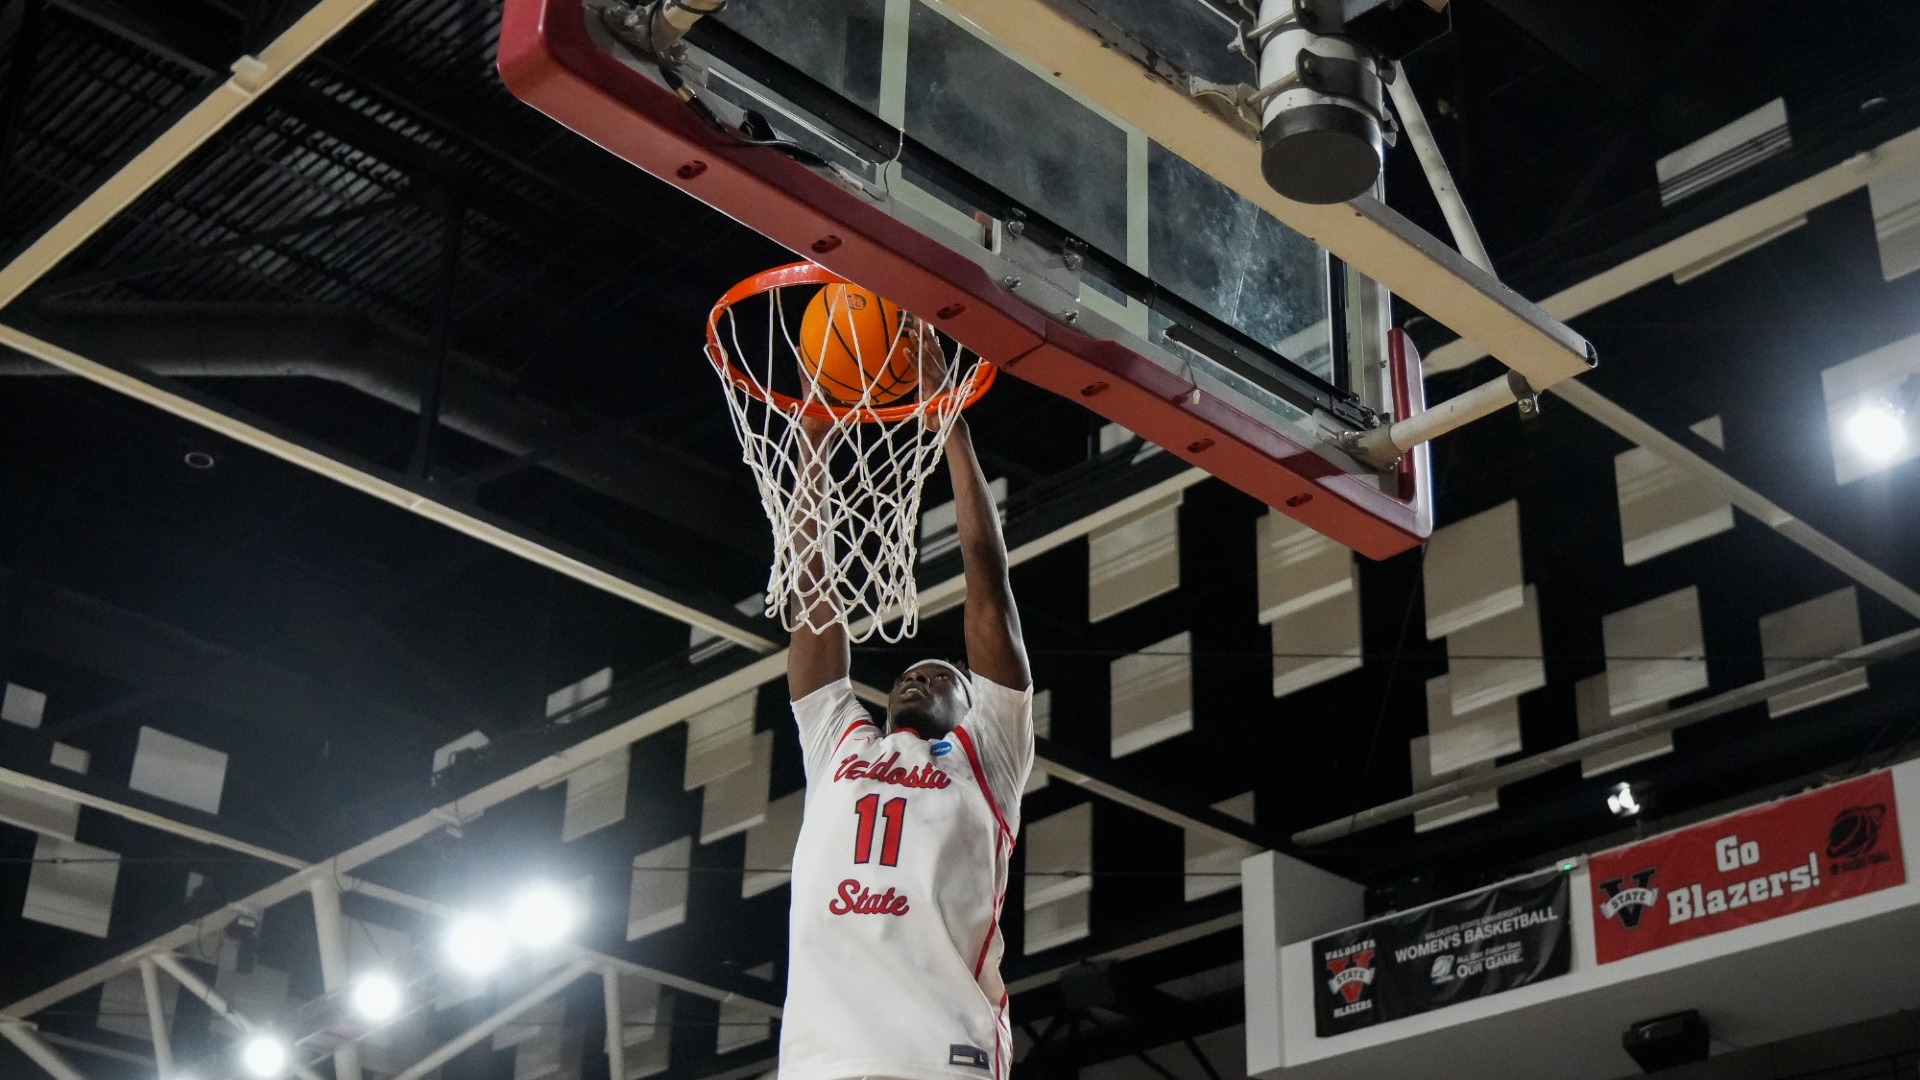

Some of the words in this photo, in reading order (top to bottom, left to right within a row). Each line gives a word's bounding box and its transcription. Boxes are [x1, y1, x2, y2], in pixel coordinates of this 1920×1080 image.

[854, 793, 908, 868] 11
[1715, 835, 1760, 873] Go
[829, 878, 910, 917] State
[1610, 889, 1647, 909] STATE
[1666, 851, 1820, 925] Blazers!
[1325, 939, 1376, 961] VALDOSTA
[1395, 932, 1462, 963] WOMEN'S
[1464, 906, 1559, 944] BASKETBALL
